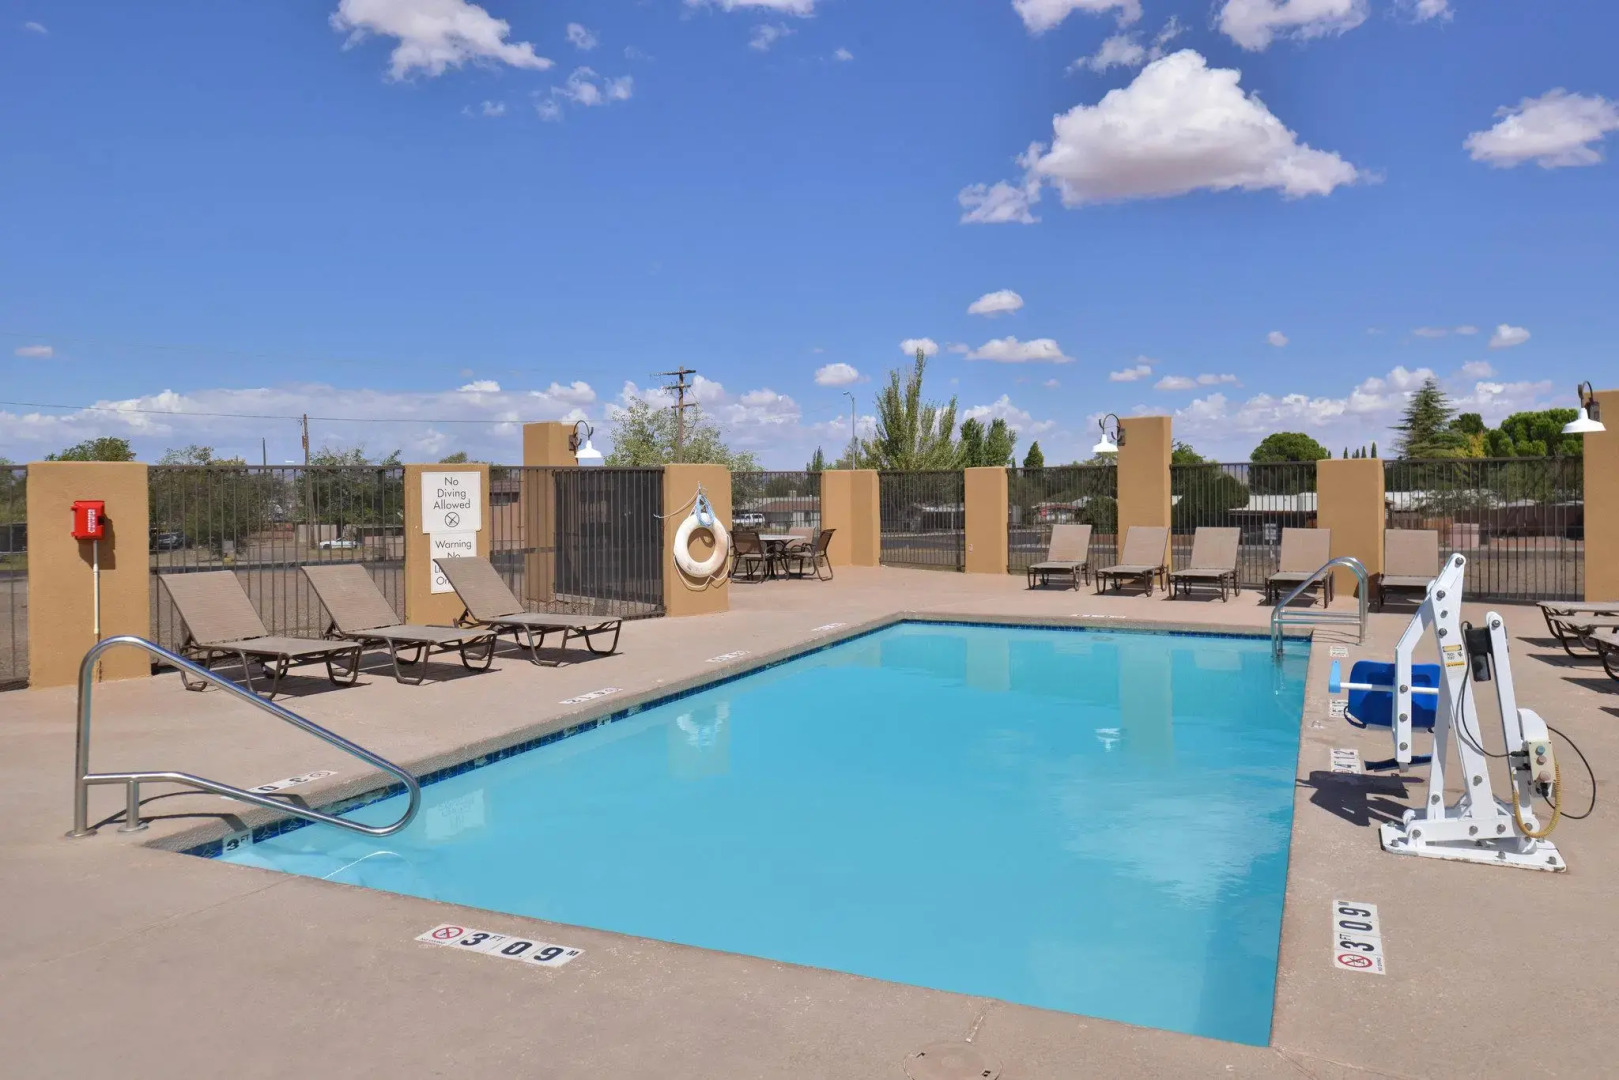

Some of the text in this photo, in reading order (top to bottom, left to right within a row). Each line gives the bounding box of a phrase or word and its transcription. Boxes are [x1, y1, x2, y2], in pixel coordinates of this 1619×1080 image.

[444, 477, 458, 486] No
[437, 488, 466, 500] Diving
[433, 500, 470, 510] Allowed
[435, 540, 472, 550] Warning
[226, 838, 240, 850] 3
[460, 933, 490, 946] 3
[1340, 940, 1374, 952] 3
